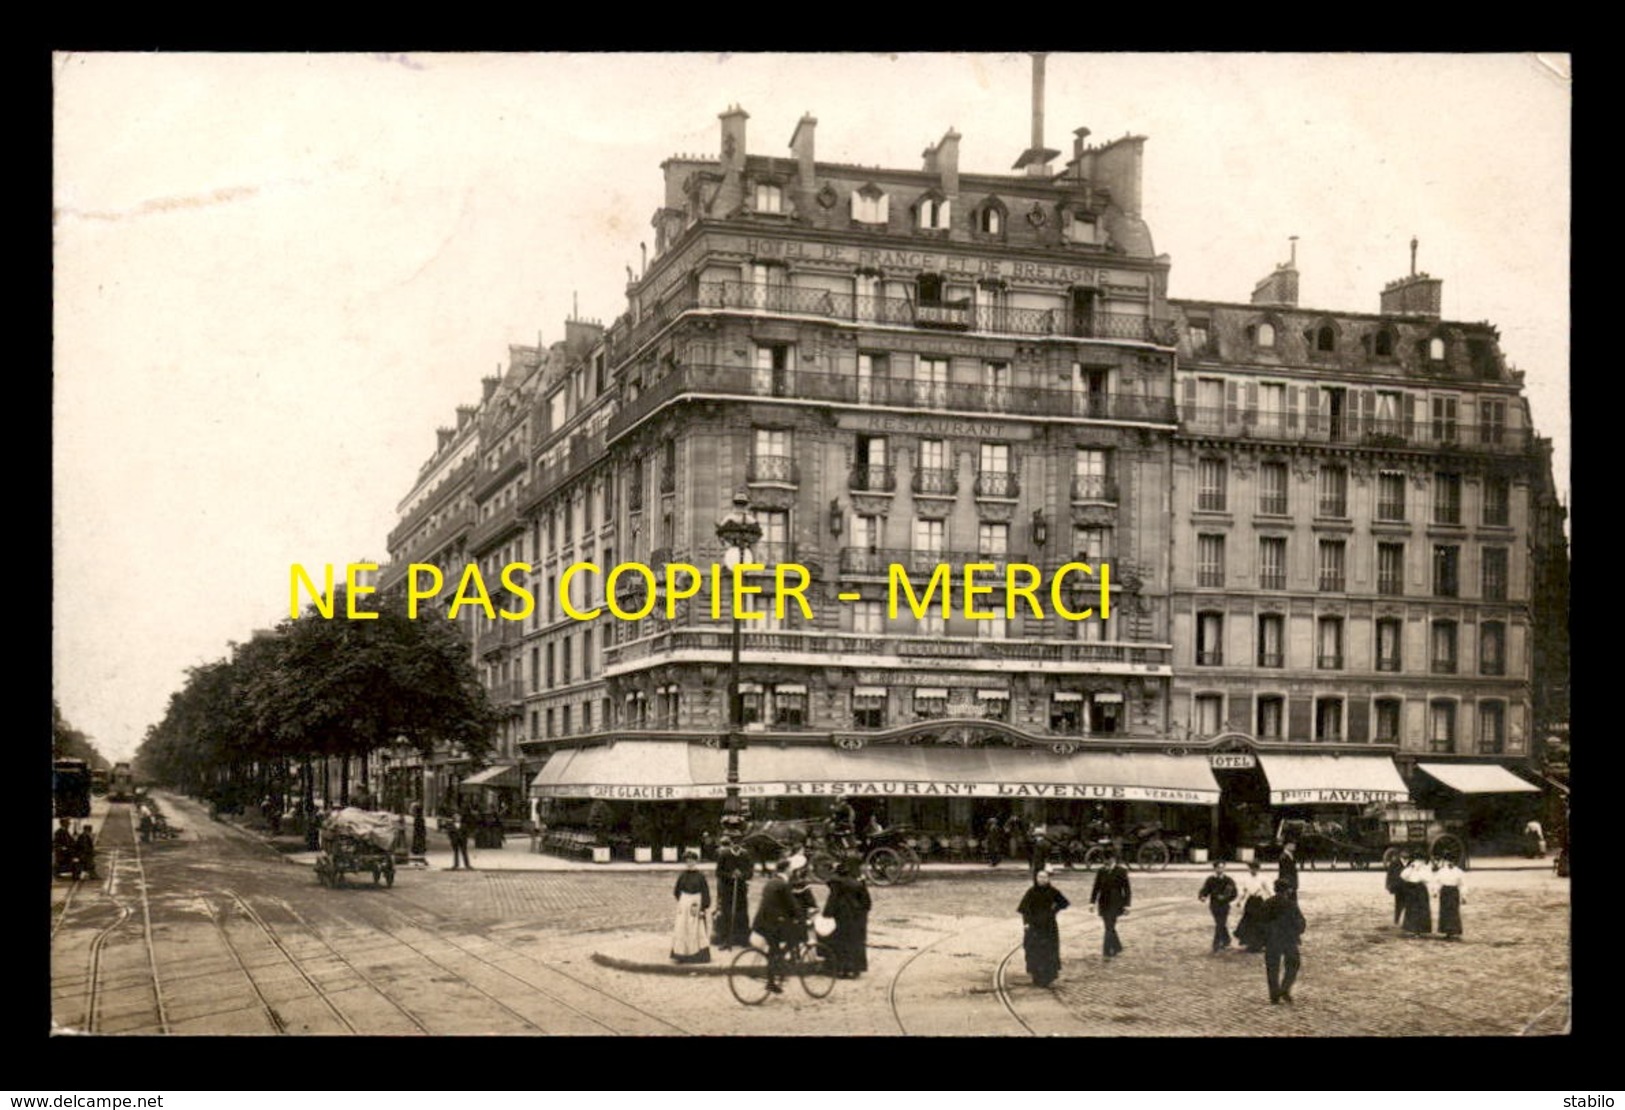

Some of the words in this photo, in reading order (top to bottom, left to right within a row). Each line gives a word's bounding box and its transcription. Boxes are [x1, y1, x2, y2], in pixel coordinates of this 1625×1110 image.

[746, 238, 810, 257] HOTEL
[822, 244, 846, 260] DE
[858, 249, 934, 269] FRANCE
[946, 257, 966, 273] ET
[979, 259, 1001, 275] DE
[1013, 261, 1110, 283] BRETAGNE
[868, 416, 1005, 437] RESTAURANT
[617, 787, 674, 798] GLACIER
[785, 783, 978, 795] RESTAURANT
[998, 784, 1127, 798] LAVENUE
[1145, 789, 1200, 800] VERANDA
[1318, 790, 1398, 802] LAVENUE
